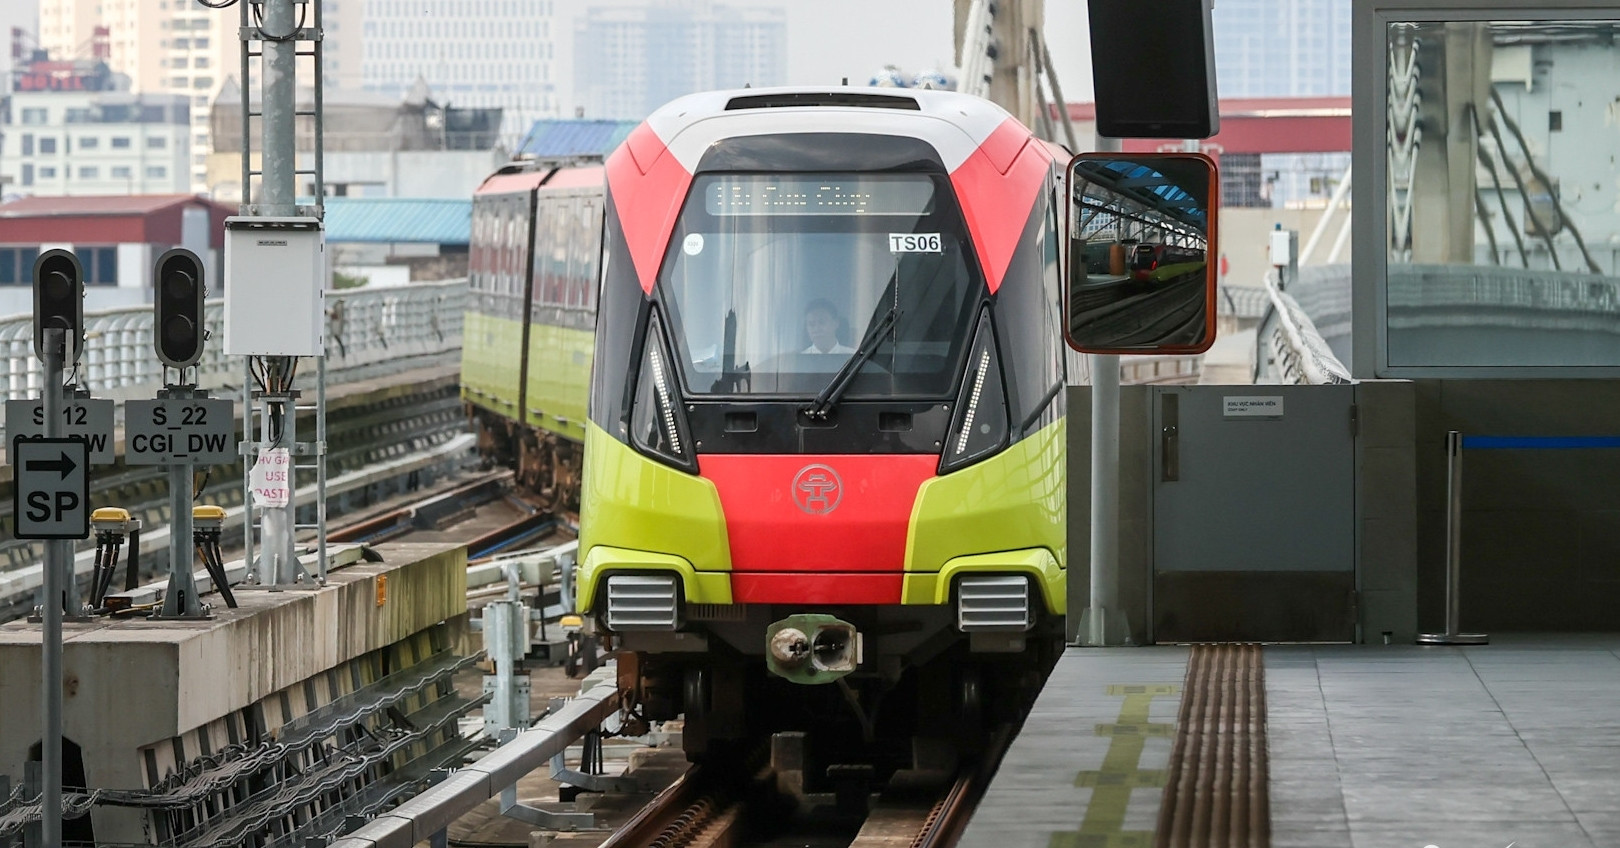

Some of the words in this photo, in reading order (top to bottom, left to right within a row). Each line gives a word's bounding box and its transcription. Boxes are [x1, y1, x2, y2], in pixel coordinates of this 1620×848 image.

[891, 236, 939, 251] TS06
[152, 406, 207, 430] S_22
[132, 434, 227, 458] CGI_DW
[265, 471, 286, 482] USE
[26, 491, 79, 522] SP
